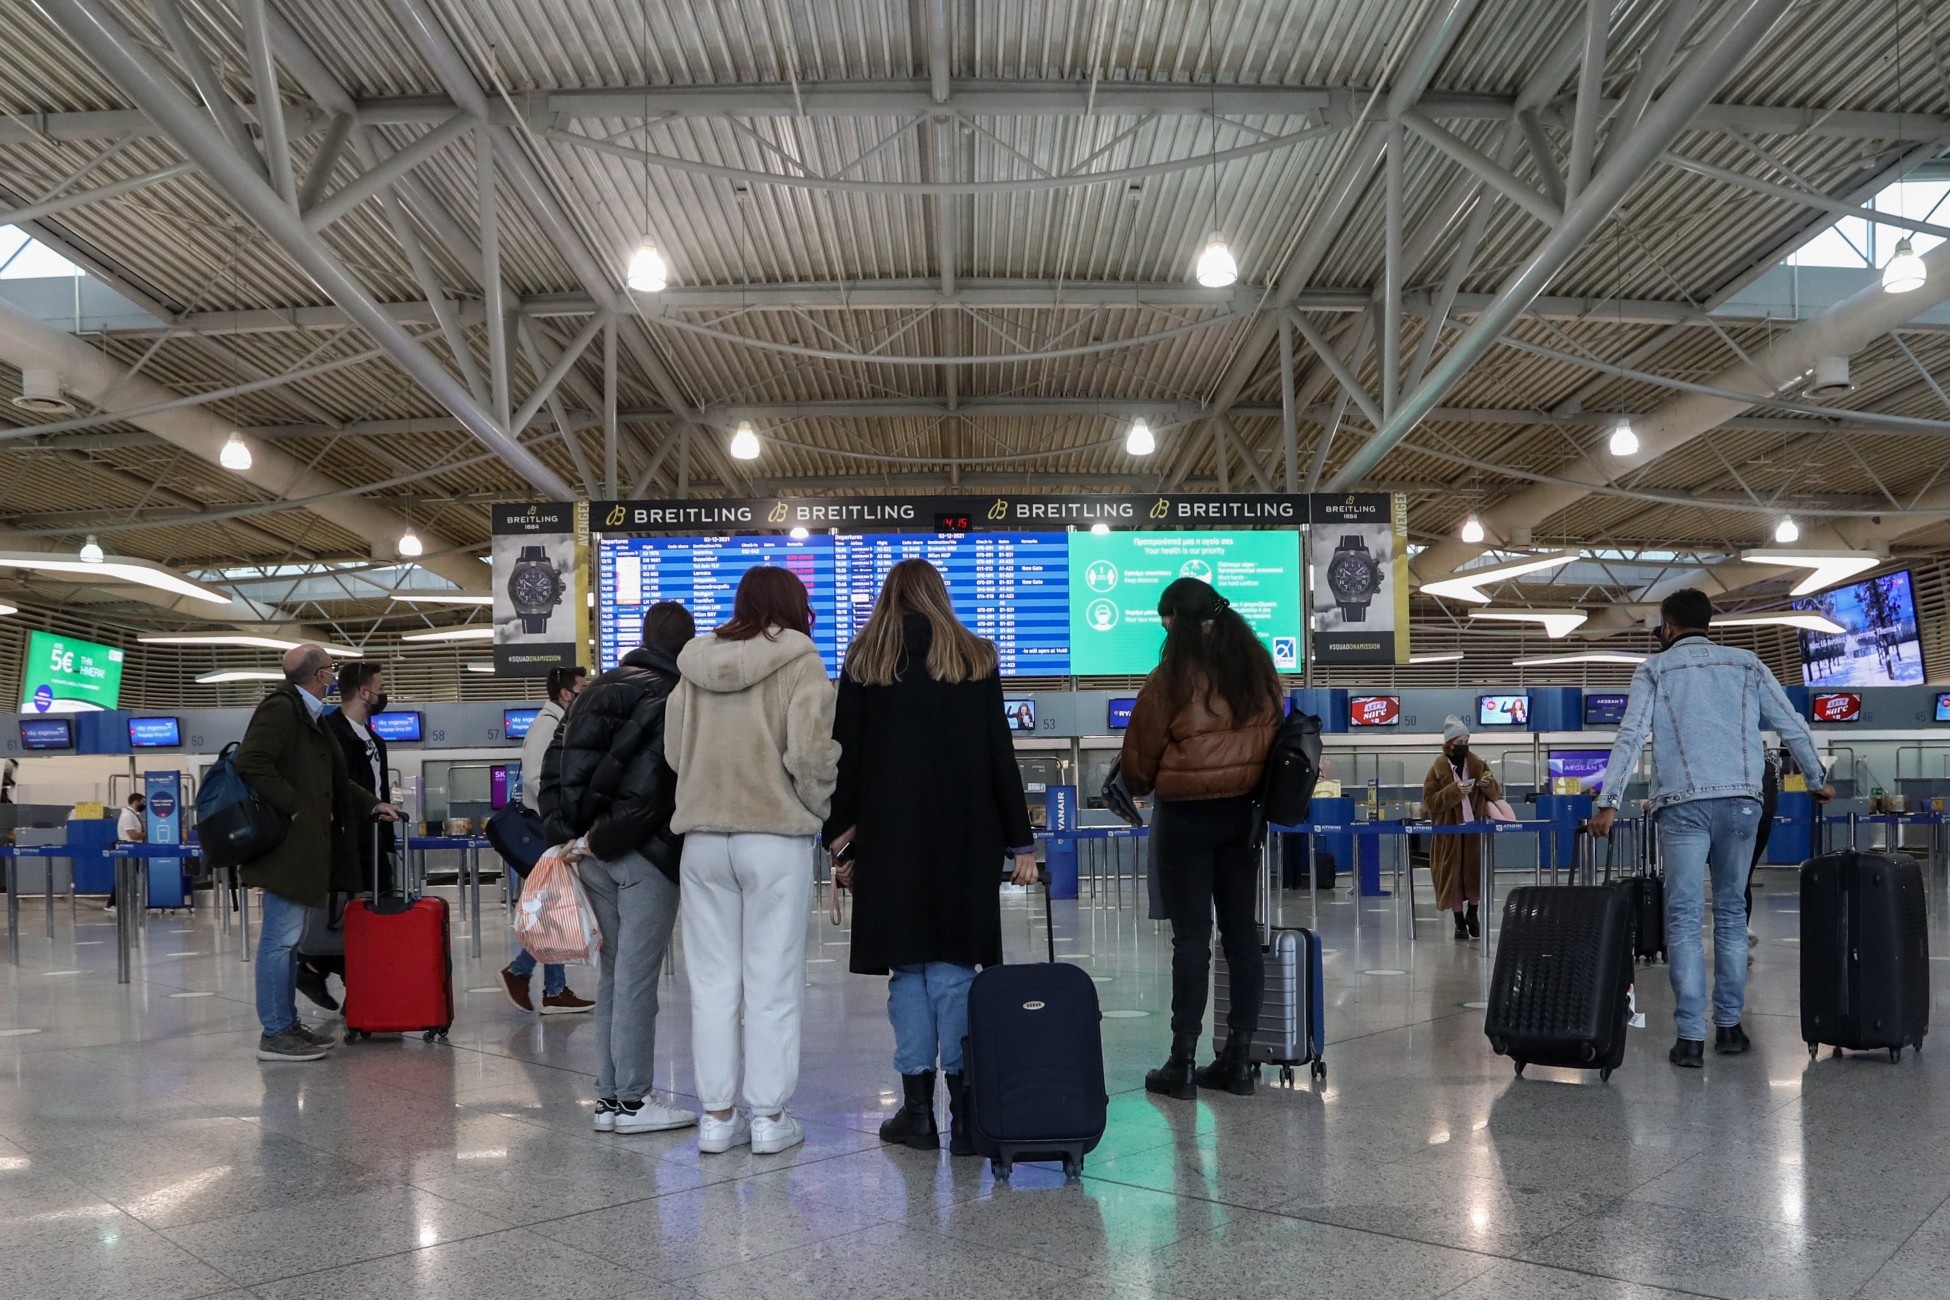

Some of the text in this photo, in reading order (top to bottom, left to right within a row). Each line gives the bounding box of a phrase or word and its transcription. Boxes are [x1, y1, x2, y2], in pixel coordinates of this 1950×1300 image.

[634, 508, 751, 523] BREITLING
[797, 506, 914, 520] BREITLING
[1017, 504, 1133, 517] BREITLING
[1178, 503, 1293, 517] BREITLING
[1202, 547, 1225, 555] priority
[50, 649, 74, 673] 5€
[1405, 716, 1417, 726] 50
[1915, 712, 1925, 722] 45
[1044, 719, 1055, 729] 53
[432, 730, 445, 741] 58
[488, 729, 499, 740] 57
[7, 740, 18, 749] 61
[191, 736, 203, 746] 60
